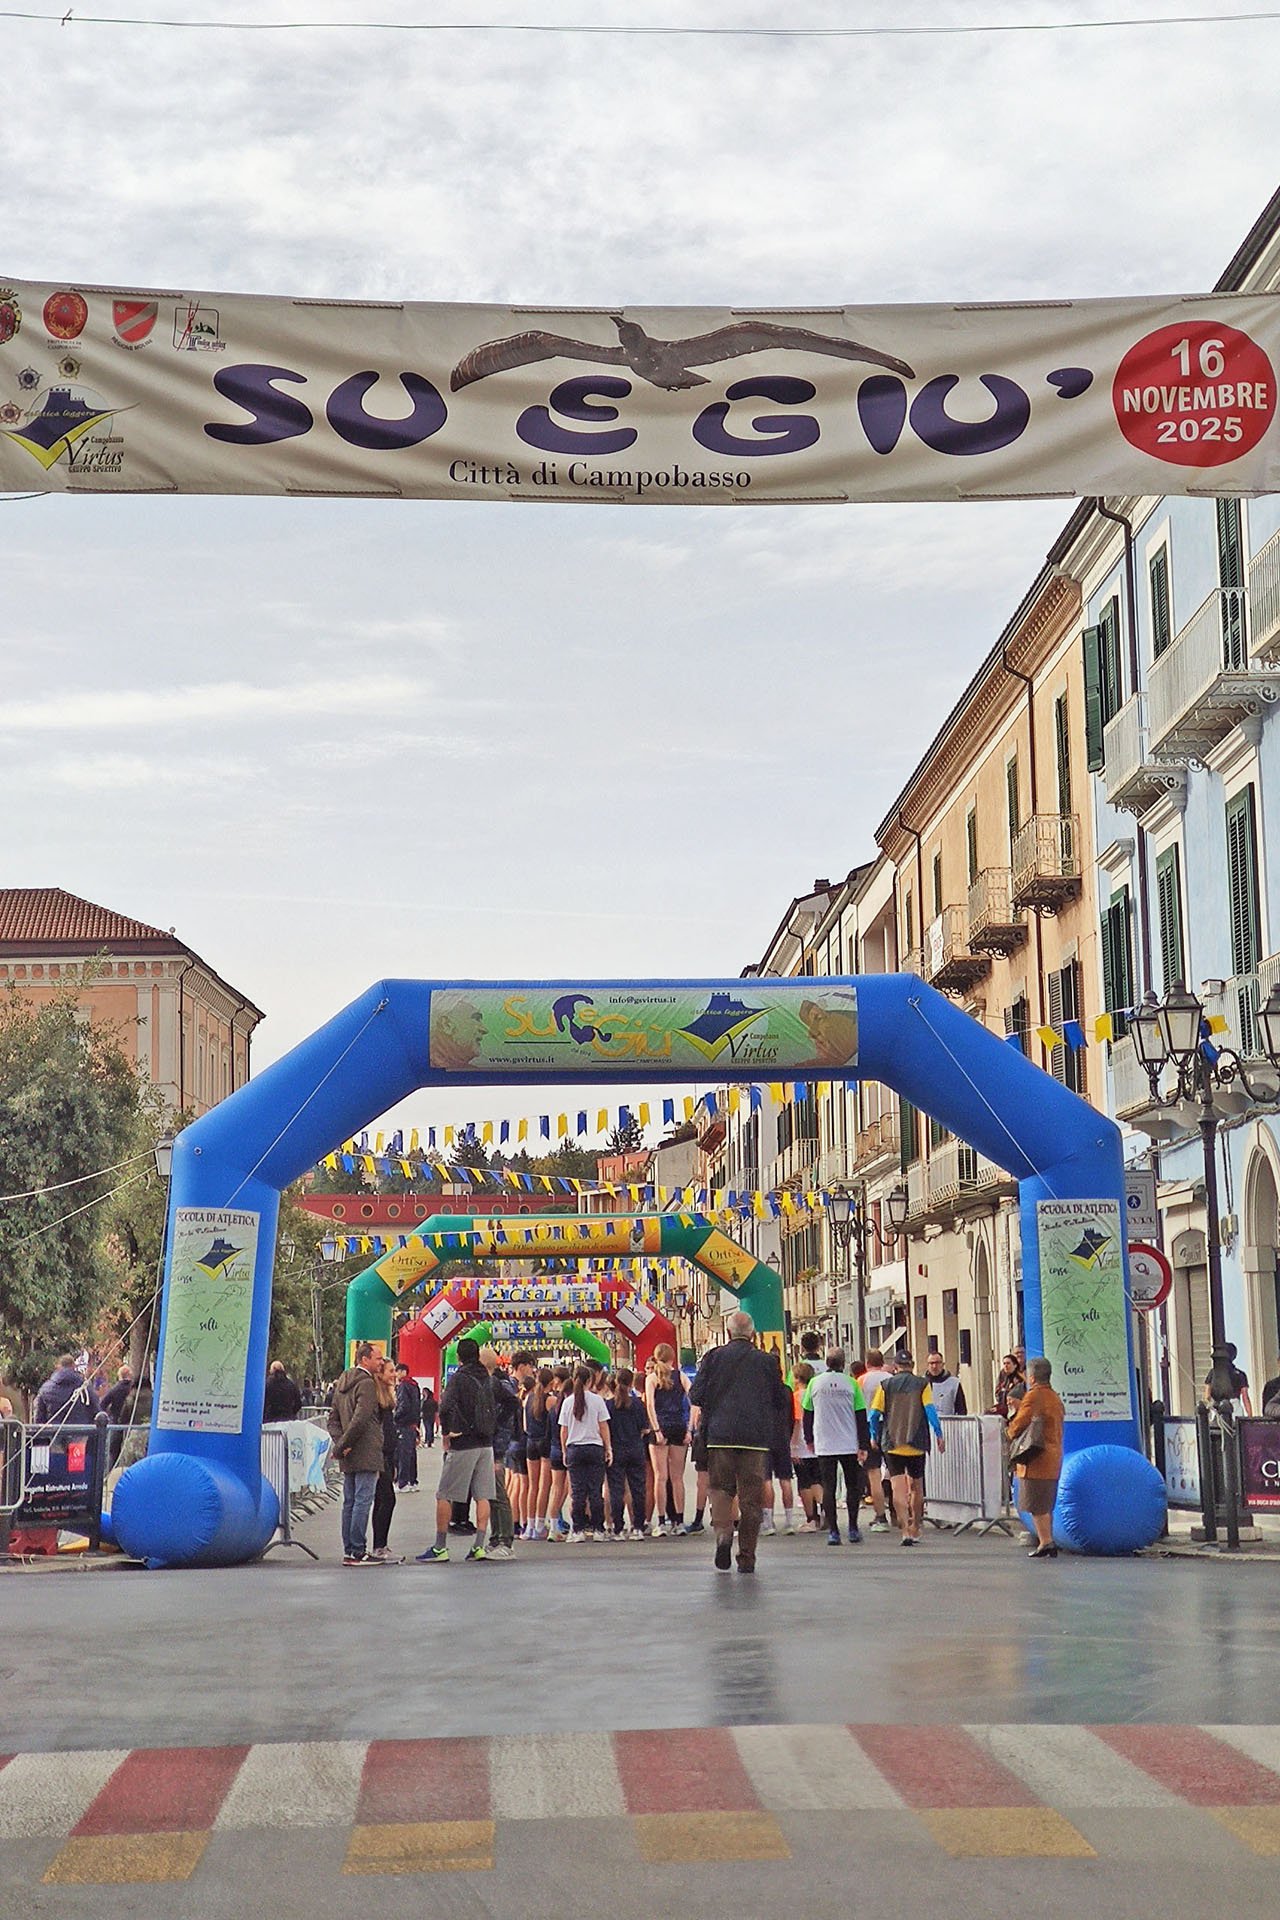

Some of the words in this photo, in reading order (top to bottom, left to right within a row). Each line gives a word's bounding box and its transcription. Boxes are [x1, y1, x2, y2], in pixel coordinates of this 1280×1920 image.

[111, 336, 133, 351] REGIONE
[1171, 338, 1225, 378] 16
[204, 363, 448, 450] SU
[1122, 380, 1268, 414] NOVEMBRE
[1156, 416, 1244, 444] 2025
[59, 436, 124, 466] Virtus
[449, 459, 521, 485] Città
[532, 462, 558, 486] di
[568, 462, 752, 495] Campobasso
[609, 996, 677, 1005] info@gsvirtus.it
[722, 1033, 779, 1058] Virtus
[489, 1056, 555, 1064] www.gsvirtus.it
[217, 1213, 256, 1227] ATLETICA
[1040, 1203, 1071, 1215] SCUOLA
[1072, 1203, 1082, 1214] DI
